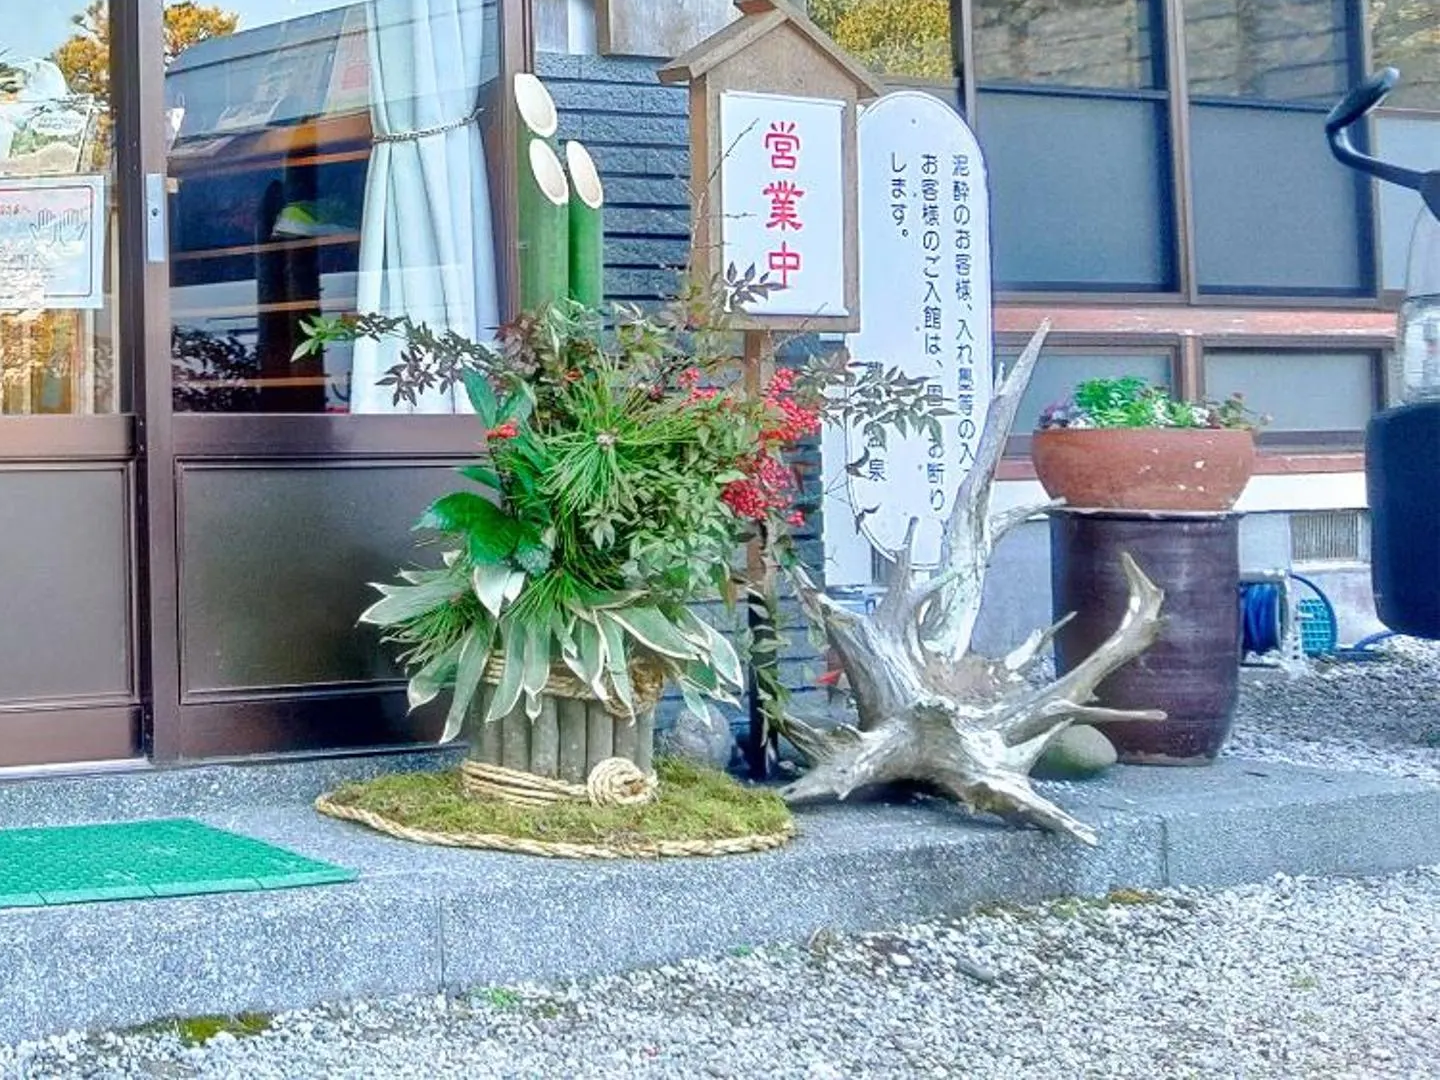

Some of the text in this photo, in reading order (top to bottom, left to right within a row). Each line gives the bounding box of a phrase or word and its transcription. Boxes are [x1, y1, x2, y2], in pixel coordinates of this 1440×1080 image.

[763, 121, 805, 289] 営業中
[890, 151, 909, 238] します。
[952, 154, 977, 473] 泥酔のお客様、入れ墨等の入
